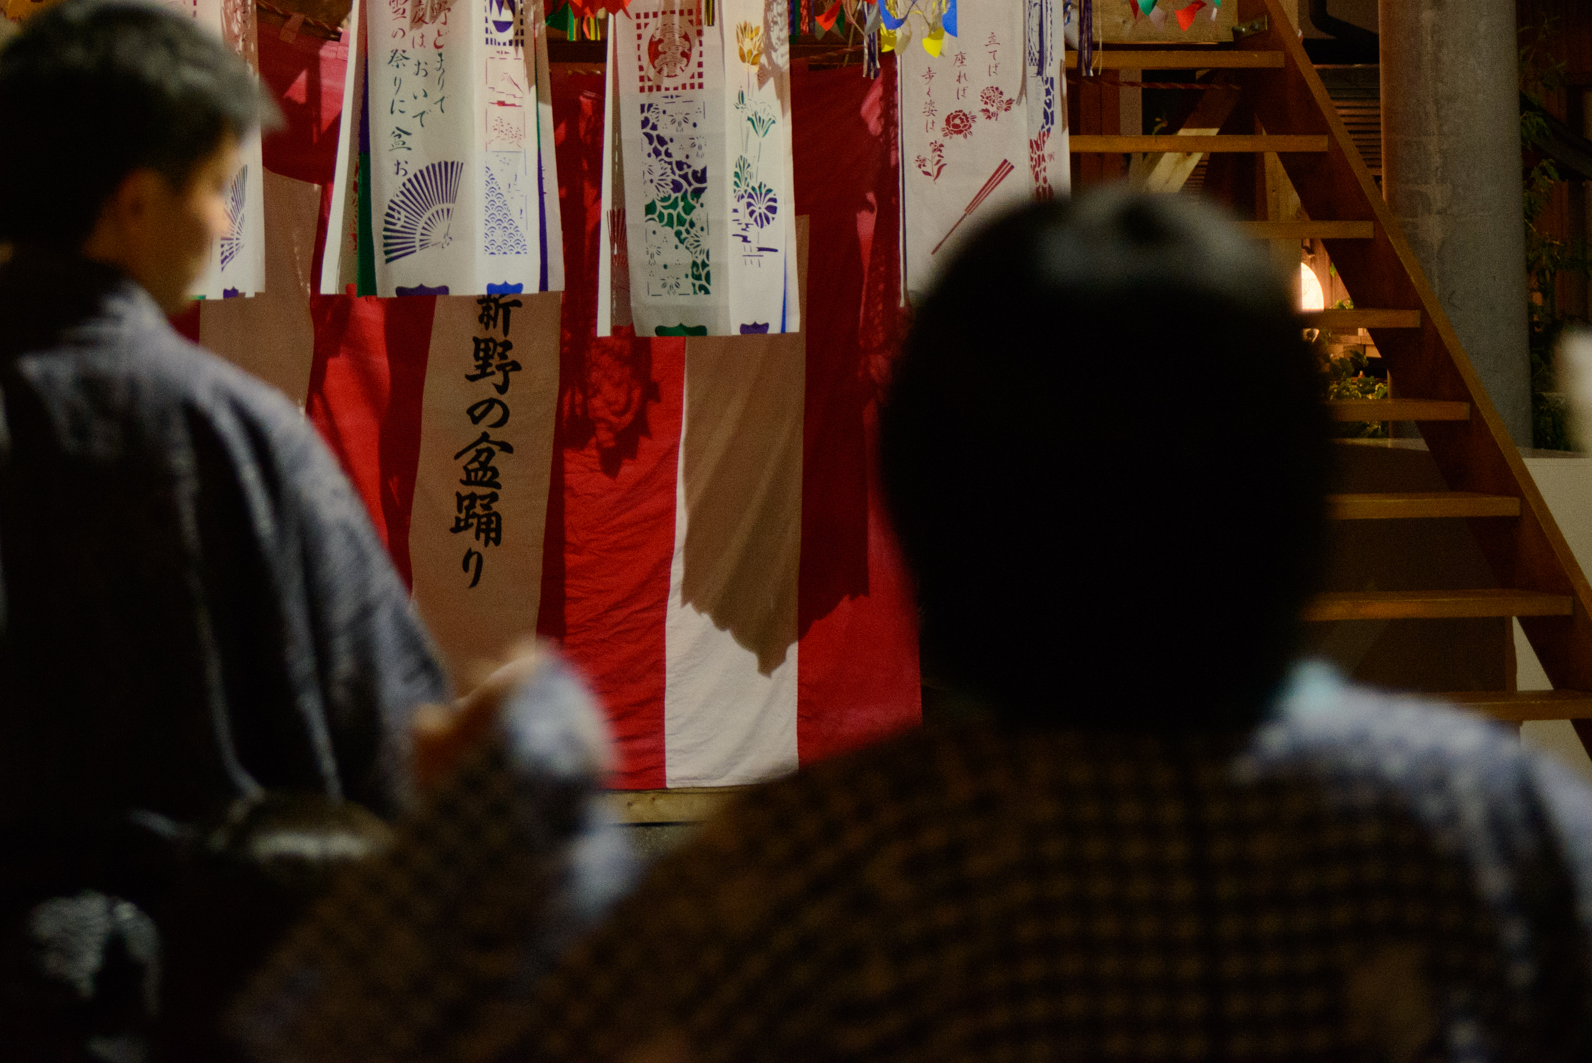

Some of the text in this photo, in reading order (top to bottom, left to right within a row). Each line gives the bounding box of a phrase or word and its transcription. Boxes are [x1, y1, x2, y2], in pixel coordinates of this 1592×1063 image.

[449, 294, 523, 588] 新野の盆踊り
